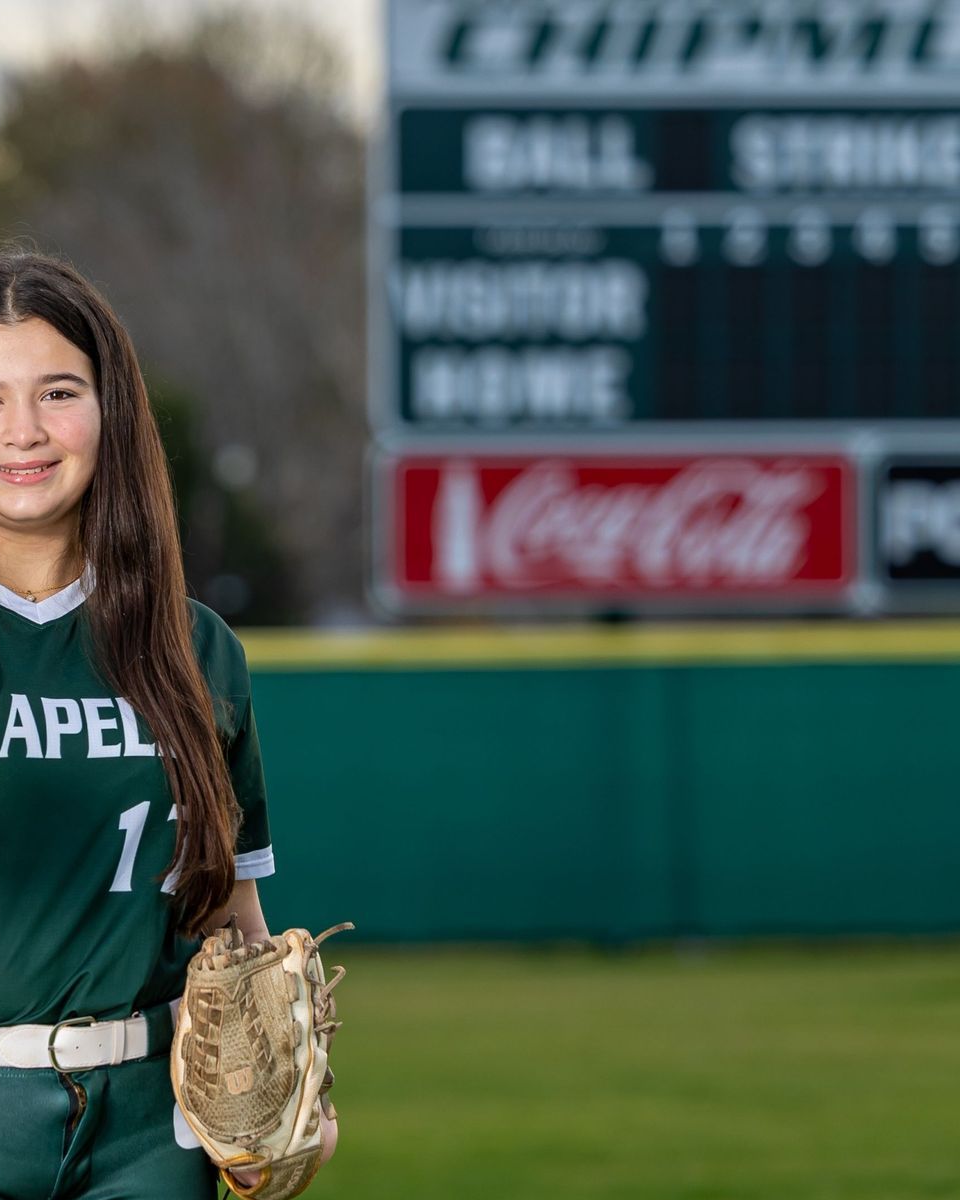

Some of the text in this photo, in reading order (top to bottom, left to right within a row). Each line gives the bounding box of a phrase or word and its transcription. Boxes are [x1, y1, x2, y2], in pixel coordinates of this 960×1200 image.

[464, 117, 648, 189] BALL
[398, 262, 645, 337] VISITOR
[413, 348, 626, 417] HOME
